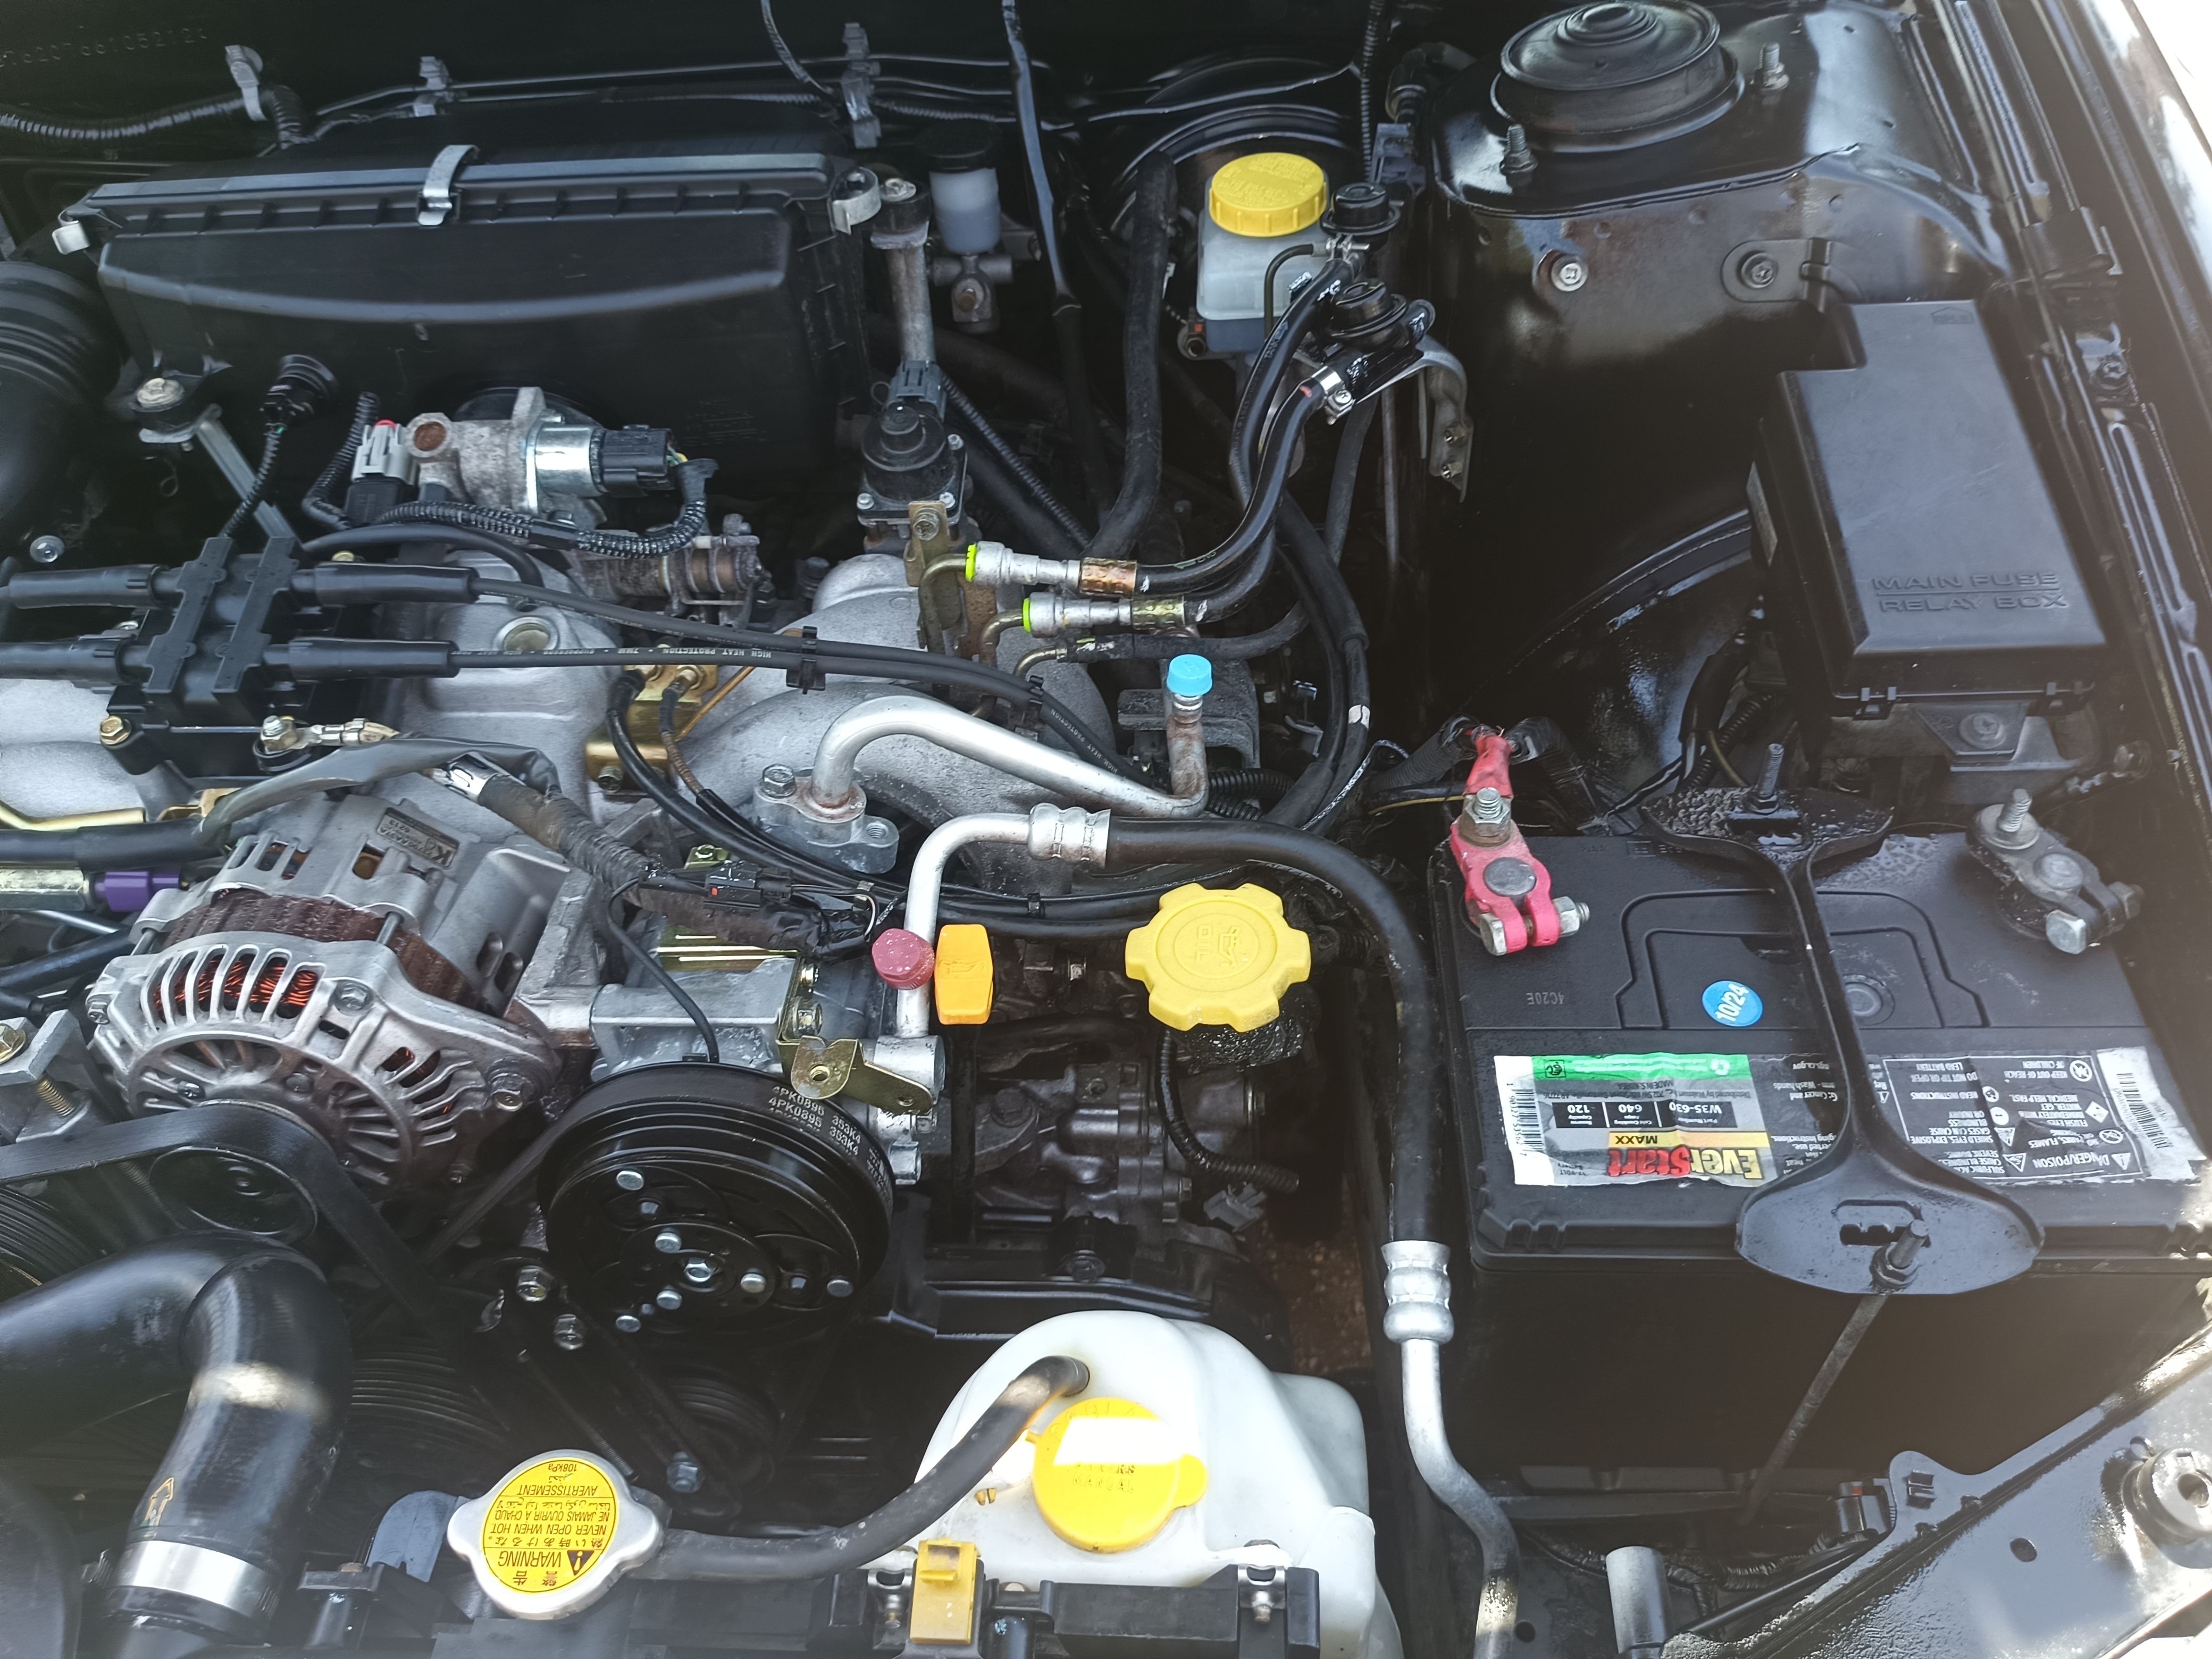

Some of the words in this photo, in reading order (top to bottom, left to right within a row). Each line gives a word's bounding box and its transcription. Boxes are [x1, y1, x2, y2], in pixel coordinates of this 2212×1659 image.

[1871, 574, 1963, 590] MAIN
[1969, 572, 2058, 587] FUSE
[1879, 596, 1985, 613] RELAY
[1993, 593, 2068, 610] BOX
[751, 650, 772, 658] HIGH
[1195, 924, 1213, 962] OIL
[1526, 992, 1564, 1005] 4C20E
[1714, 983, 1749, 1022] 10/24
[1966, 1071, 1979, 1082] DO
[1567, 1104, 1589, 1113] 120
[1618, 1104, 1643, 1113] 640
[1669, 1102, 1723, 1115] W35-630
[1615, 1135, 1658, 1144] MAXX
[1909, 1136, 1948, 1144] EXPLOSIVE
[2027, 1138, 2059, 1149] FLAMES
[1607, 1145, 1764, 1180] EverStart
[2032, 1151, 2110, 1169] DANGER/POISON
[548, 1463, 578, 1473] 108kPa
[1072, 1474, 1136, 1494] MANUAL
[516, 1484, 598, 1496] AVERTISSEMENT
[534, 1511, 564, 1521] OUVRIR
[566, 1511, 597, 1522] JAMAIS
[598, 1511, 610, 1522] NE
[490, 1523, 512, 1534] HOT.
[514, 1523, 543, 1534] WHEN
[546, 1523, 572, 1535] OPEN
[575, 1524, 607, 1536] NEVER
[498, 1551, 562, 1568] WARNING
